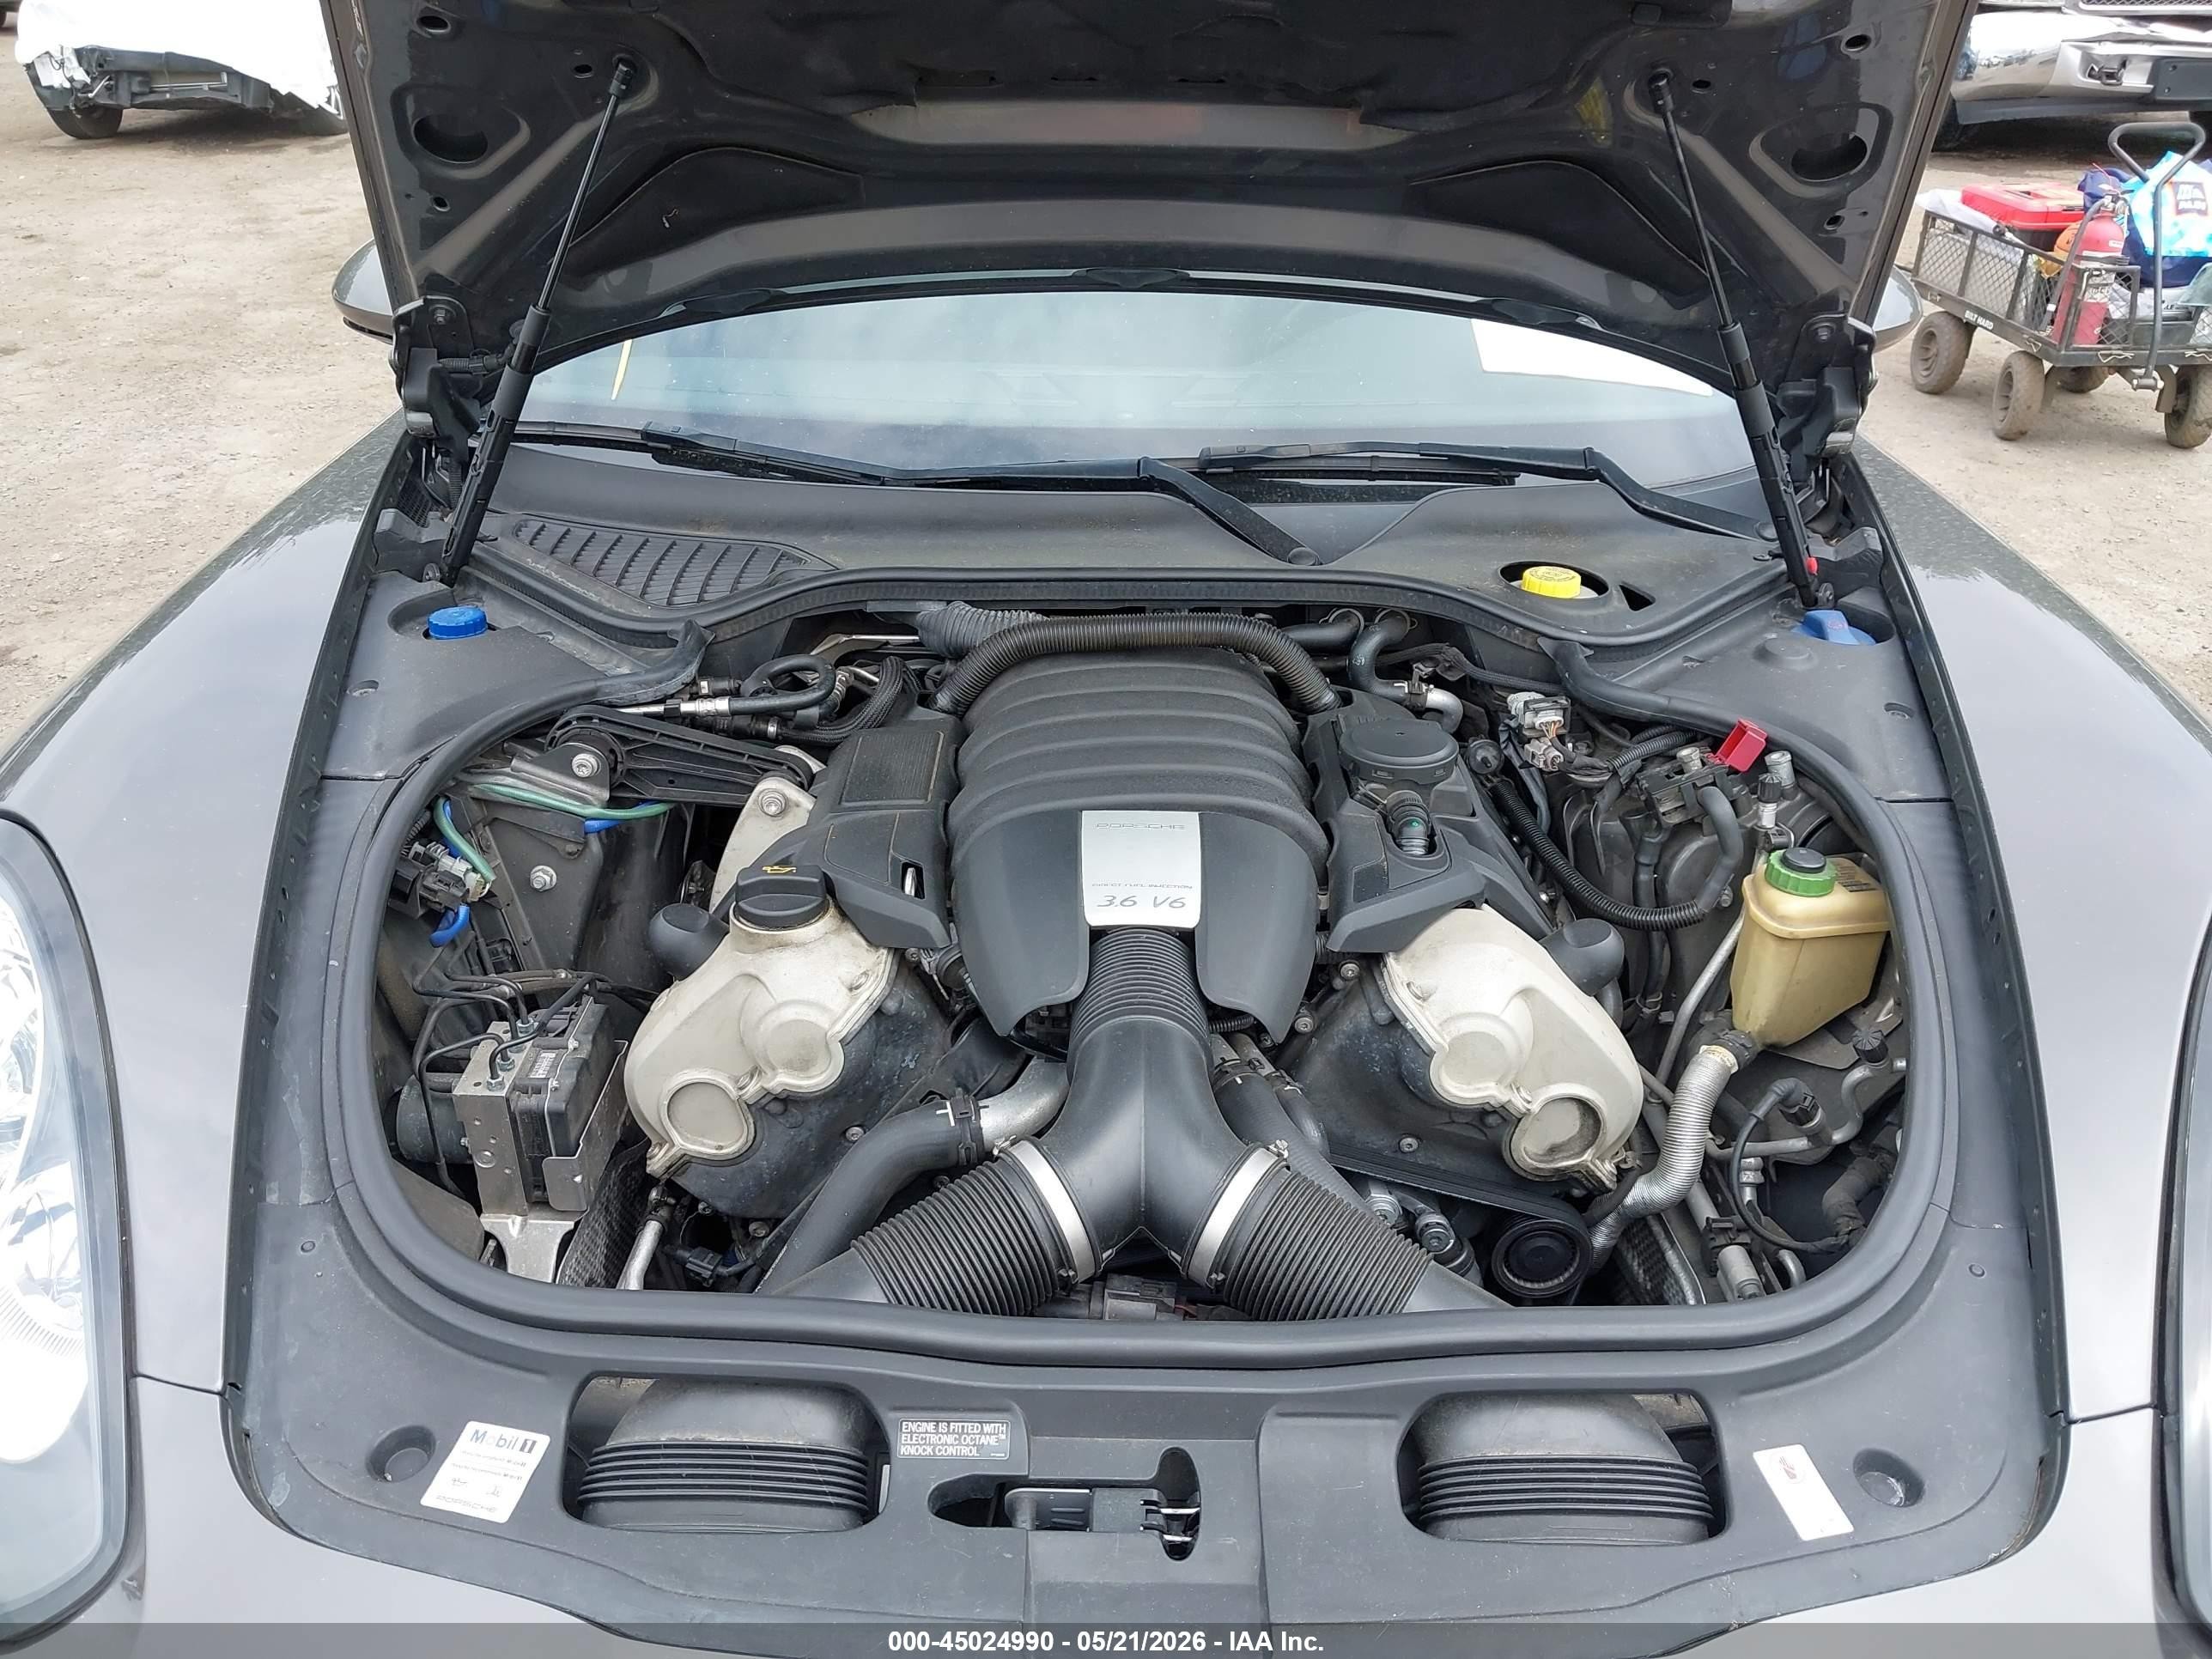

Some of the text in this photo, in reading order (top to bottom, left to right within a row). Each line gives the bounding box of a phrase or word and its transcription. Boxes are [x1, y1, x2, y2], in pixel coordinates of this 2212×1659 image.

[1097, 895, 1187, 908] 3.6 V6
[902, 1421, 1006, 1435] ENGINE IS FITTED WITH
[901, 1433, 959, 1444] ELECTRONIC
[900, 1444, 980, 1457] KNOCK CONTROL
